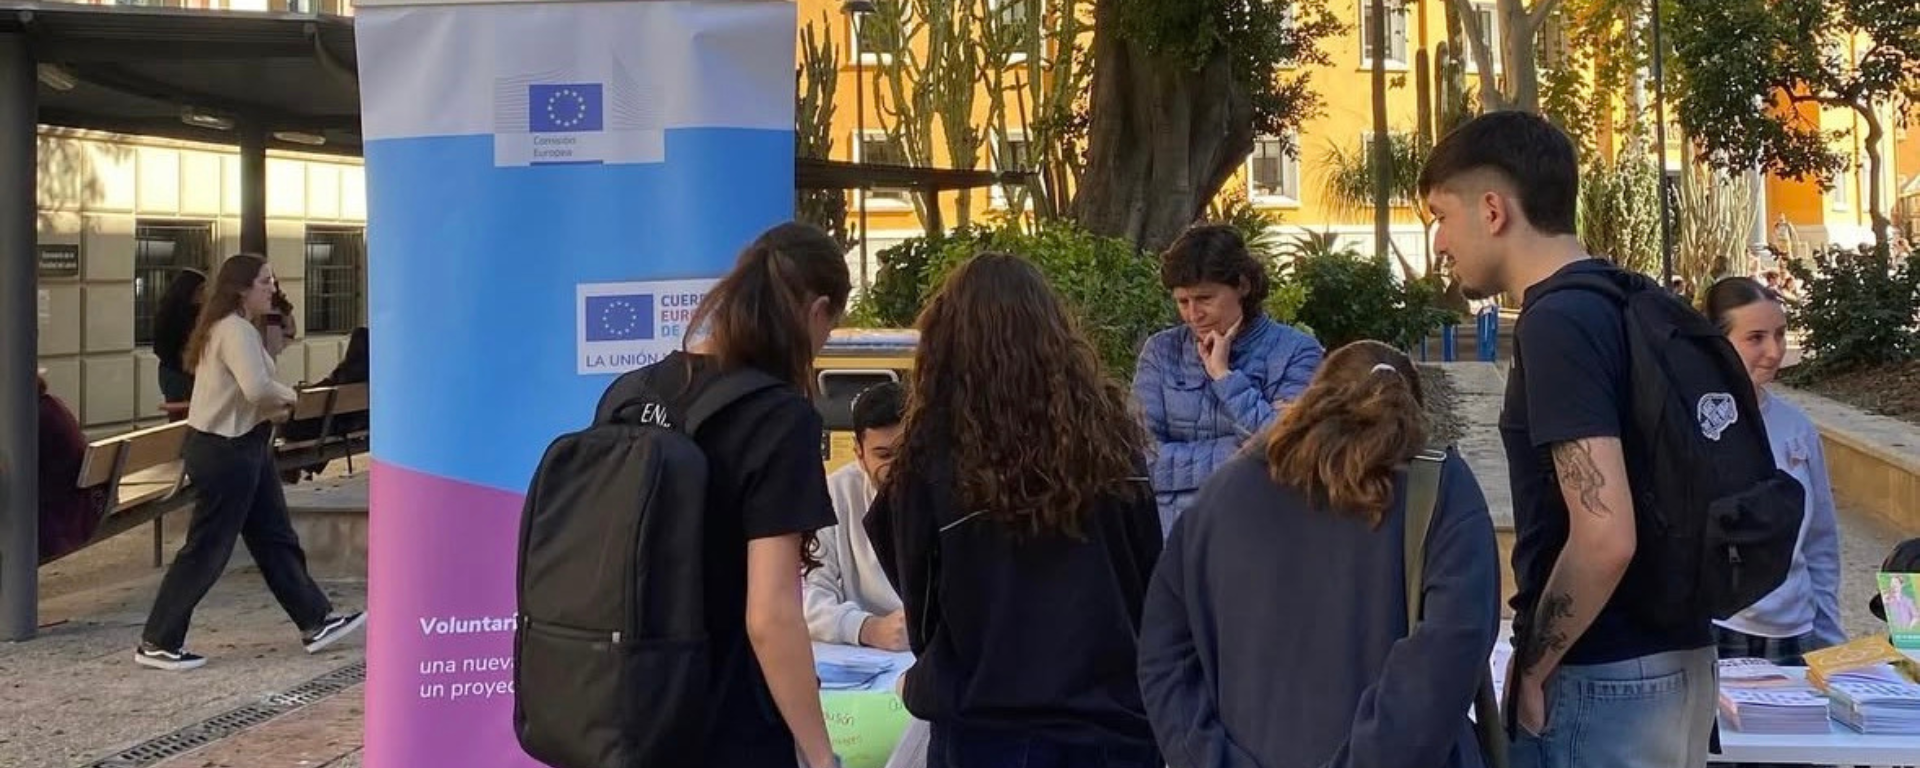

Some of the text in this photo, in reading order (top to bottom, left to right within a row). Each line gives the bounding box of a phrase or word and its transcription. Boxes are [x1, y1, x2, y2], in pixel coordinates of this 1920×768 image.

[661, 310, 693, 321] EUR
[661, 325, 680, 337] DE
[586, 350, 659, 368] LA UNIÓN
[420, 657, 515, 674] una nuev
[420, 683, 444, 698] un
